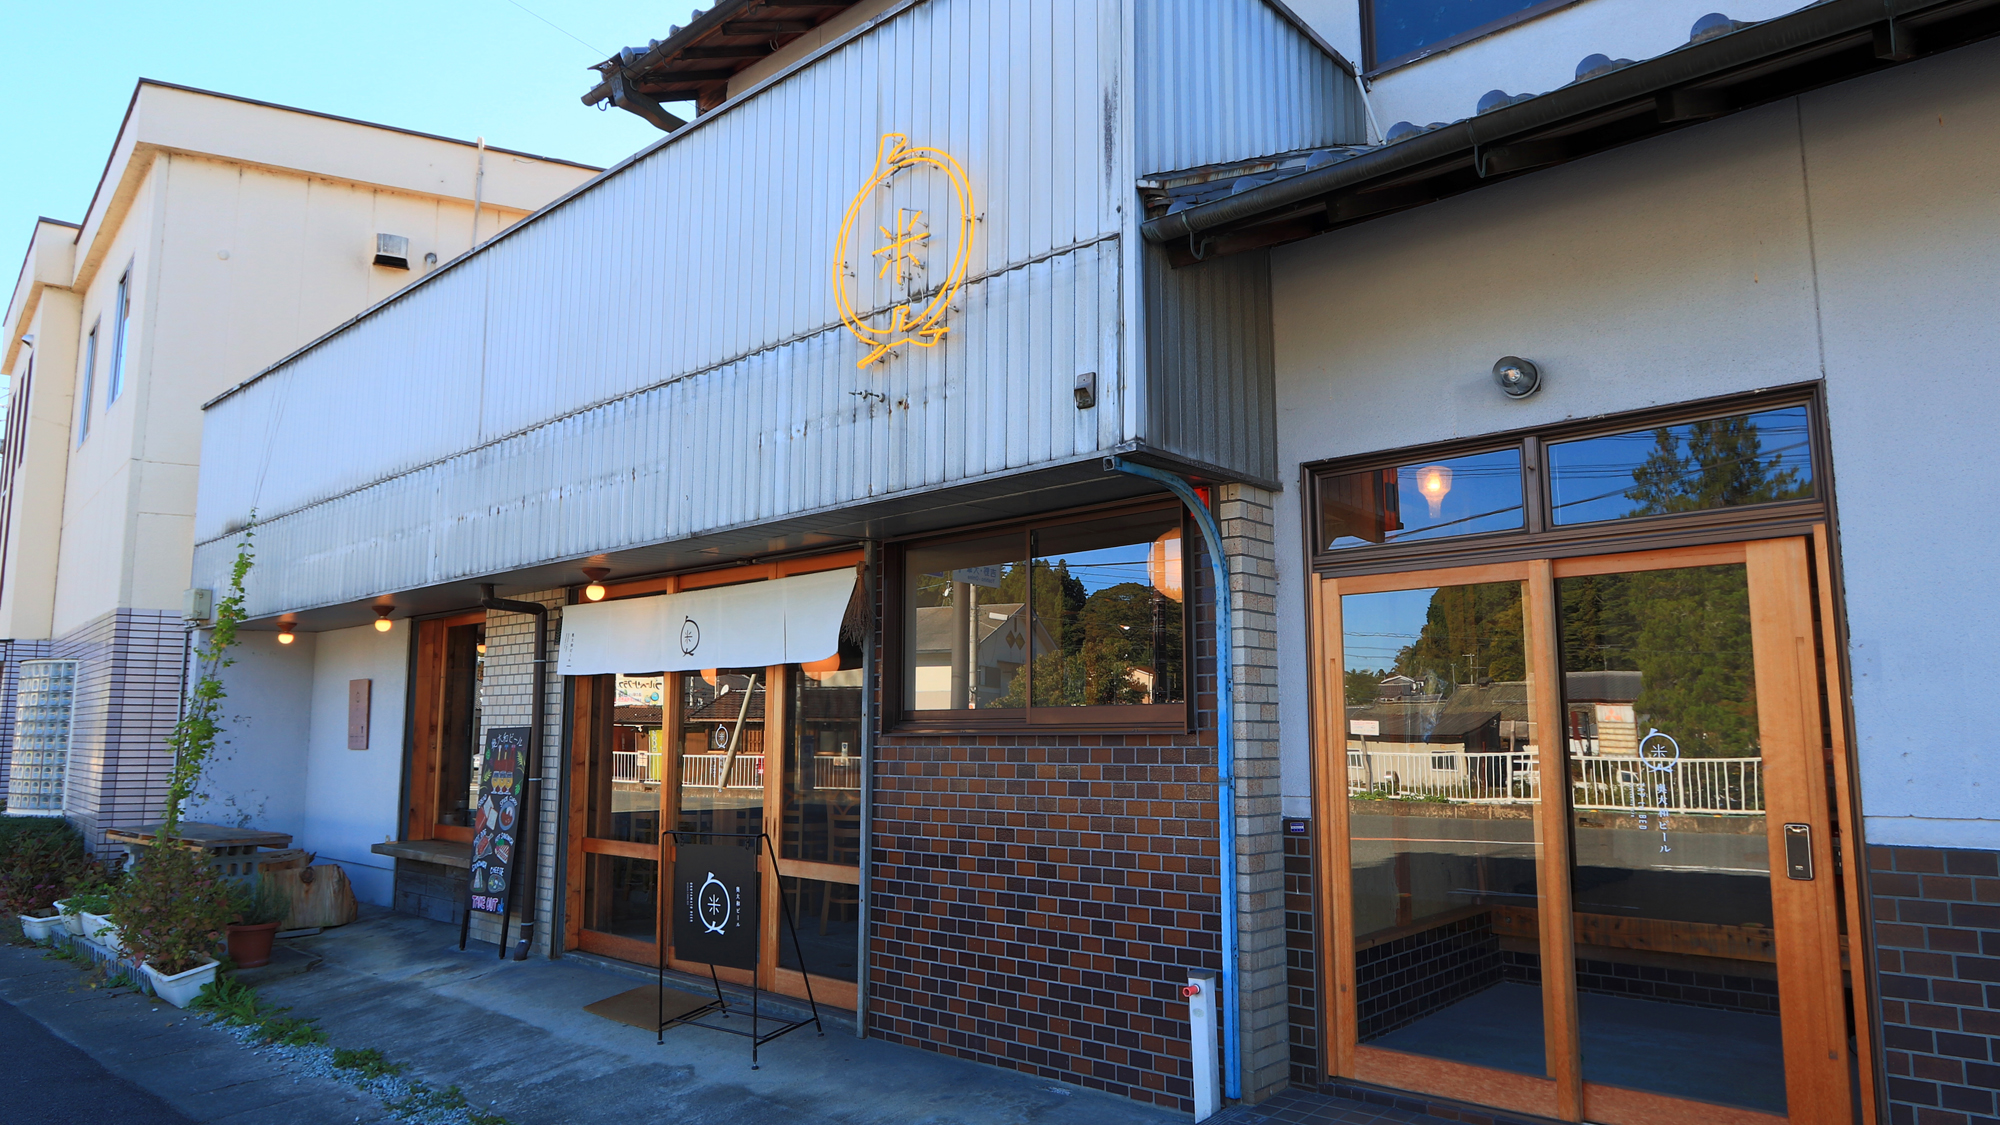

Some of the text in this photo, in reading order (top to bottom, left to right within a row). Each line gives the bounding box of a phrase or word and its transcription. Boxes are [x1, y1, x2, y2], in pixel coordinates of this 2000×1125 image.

[1638, 814, 1648, 830] BED
[1657, 783, 1671, 853] 奥大和ビール
